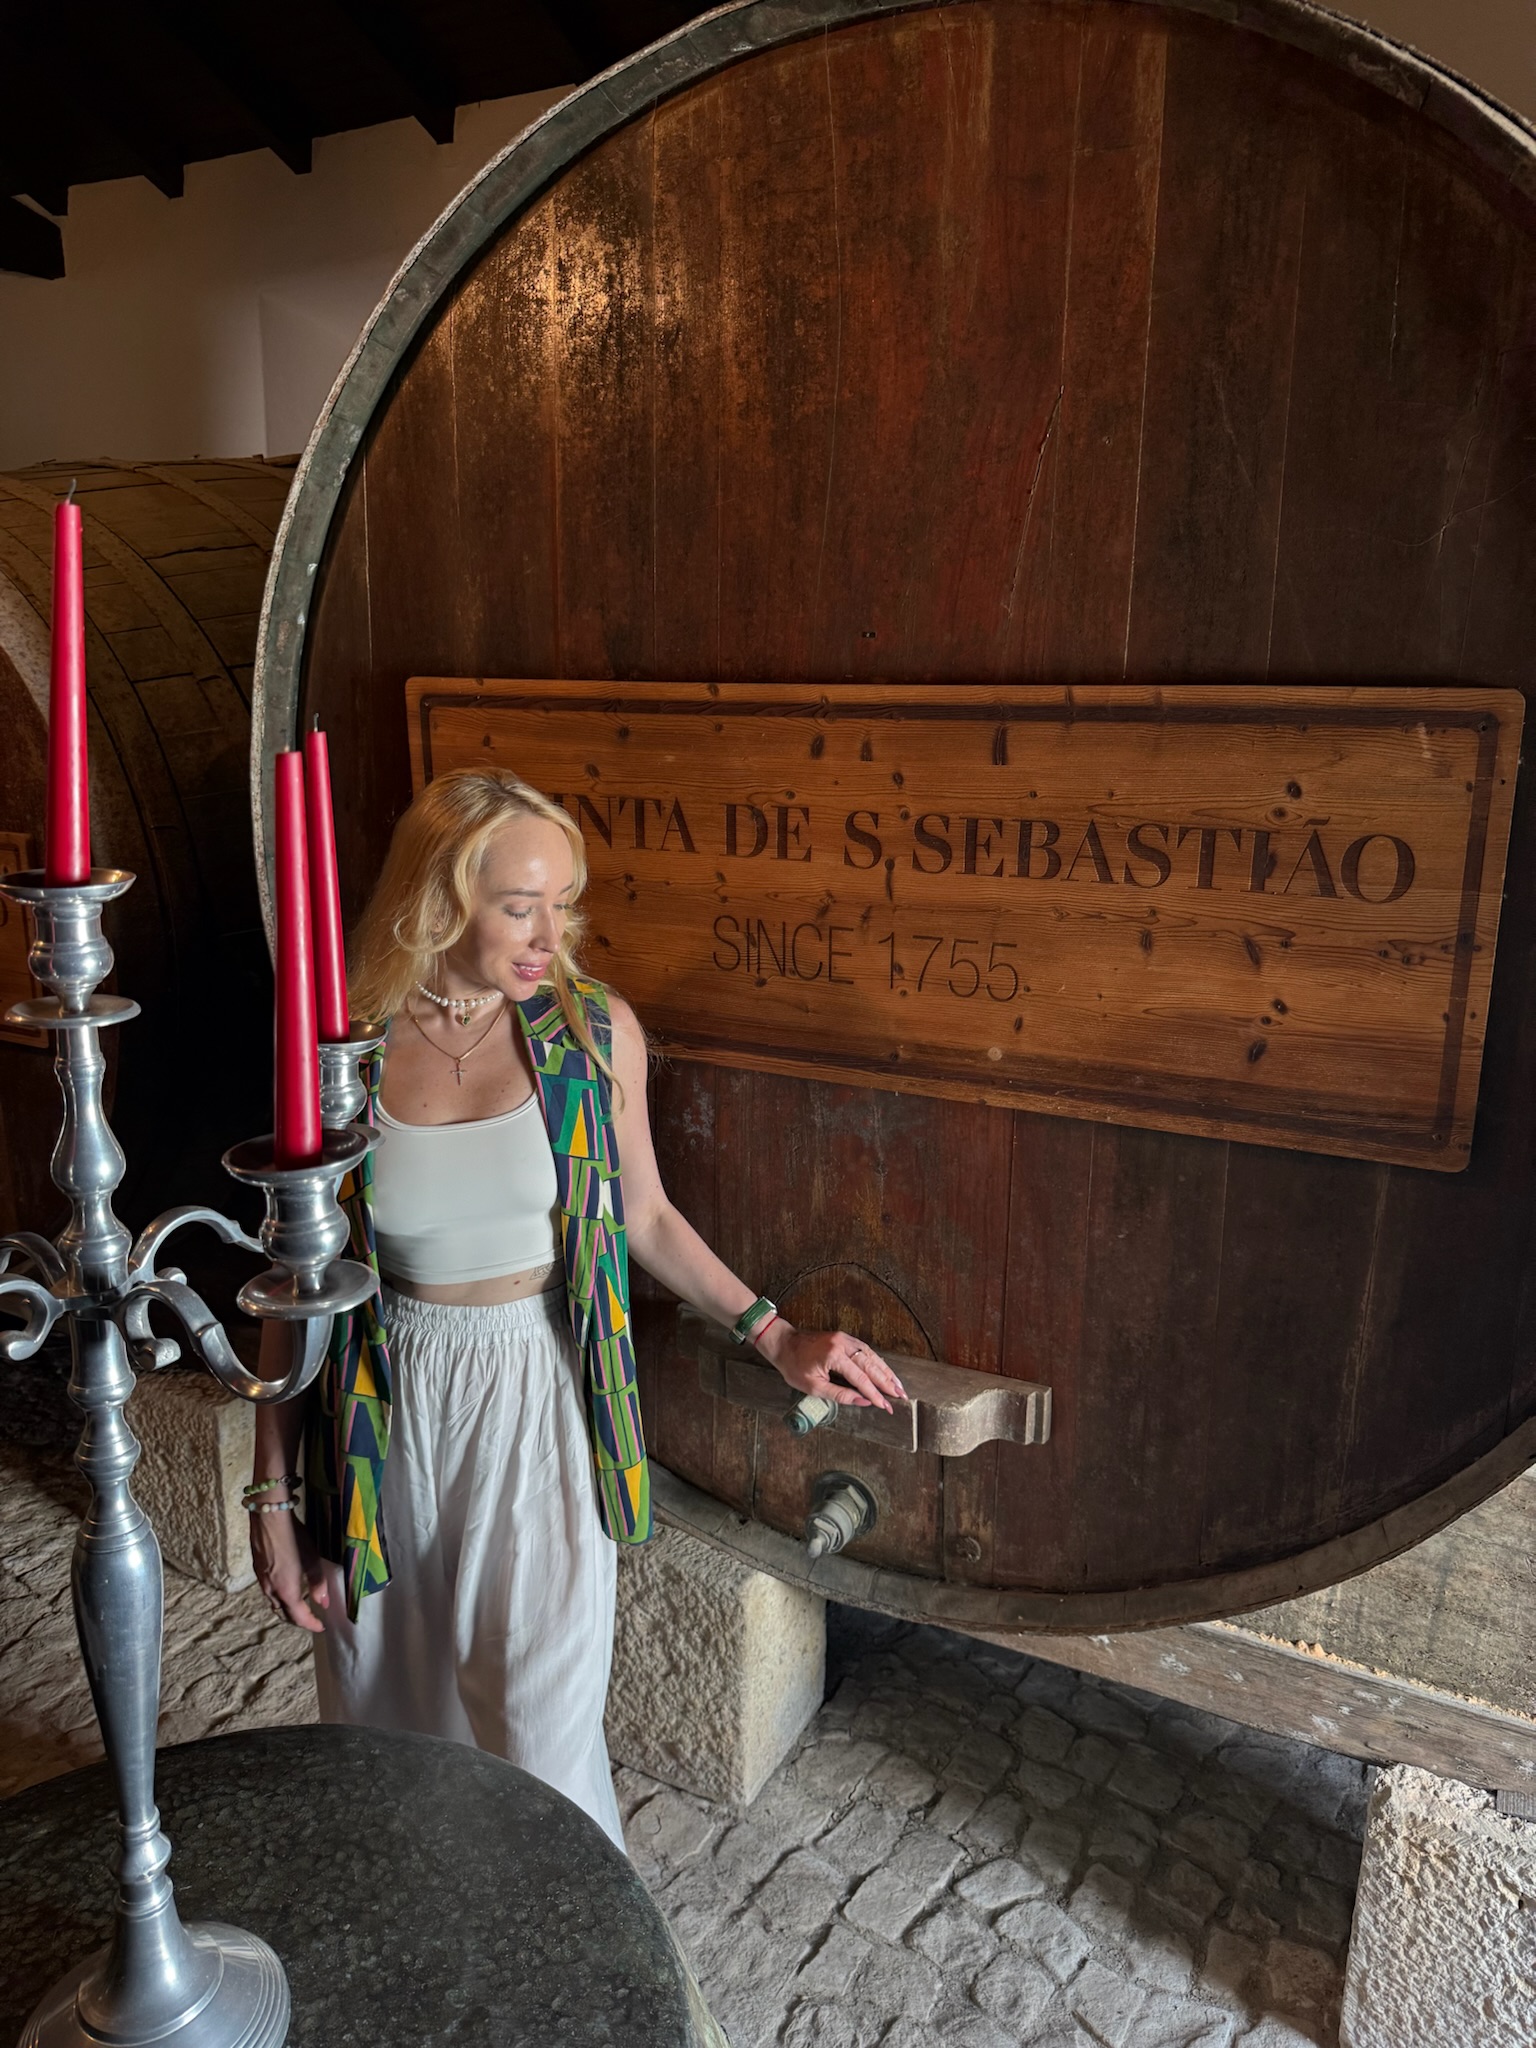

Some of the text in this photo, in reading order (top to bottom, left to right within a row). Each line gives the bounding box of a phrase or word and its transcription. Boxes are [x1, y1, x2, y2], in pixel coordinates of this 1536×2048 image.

[551, 793, 700, 854] NTA
[719, 801, 813, 863] DE
[911, 812, 1416, 904] SEBASTIÃO
[713, 914, 1019, 1002] SINCE 1755
